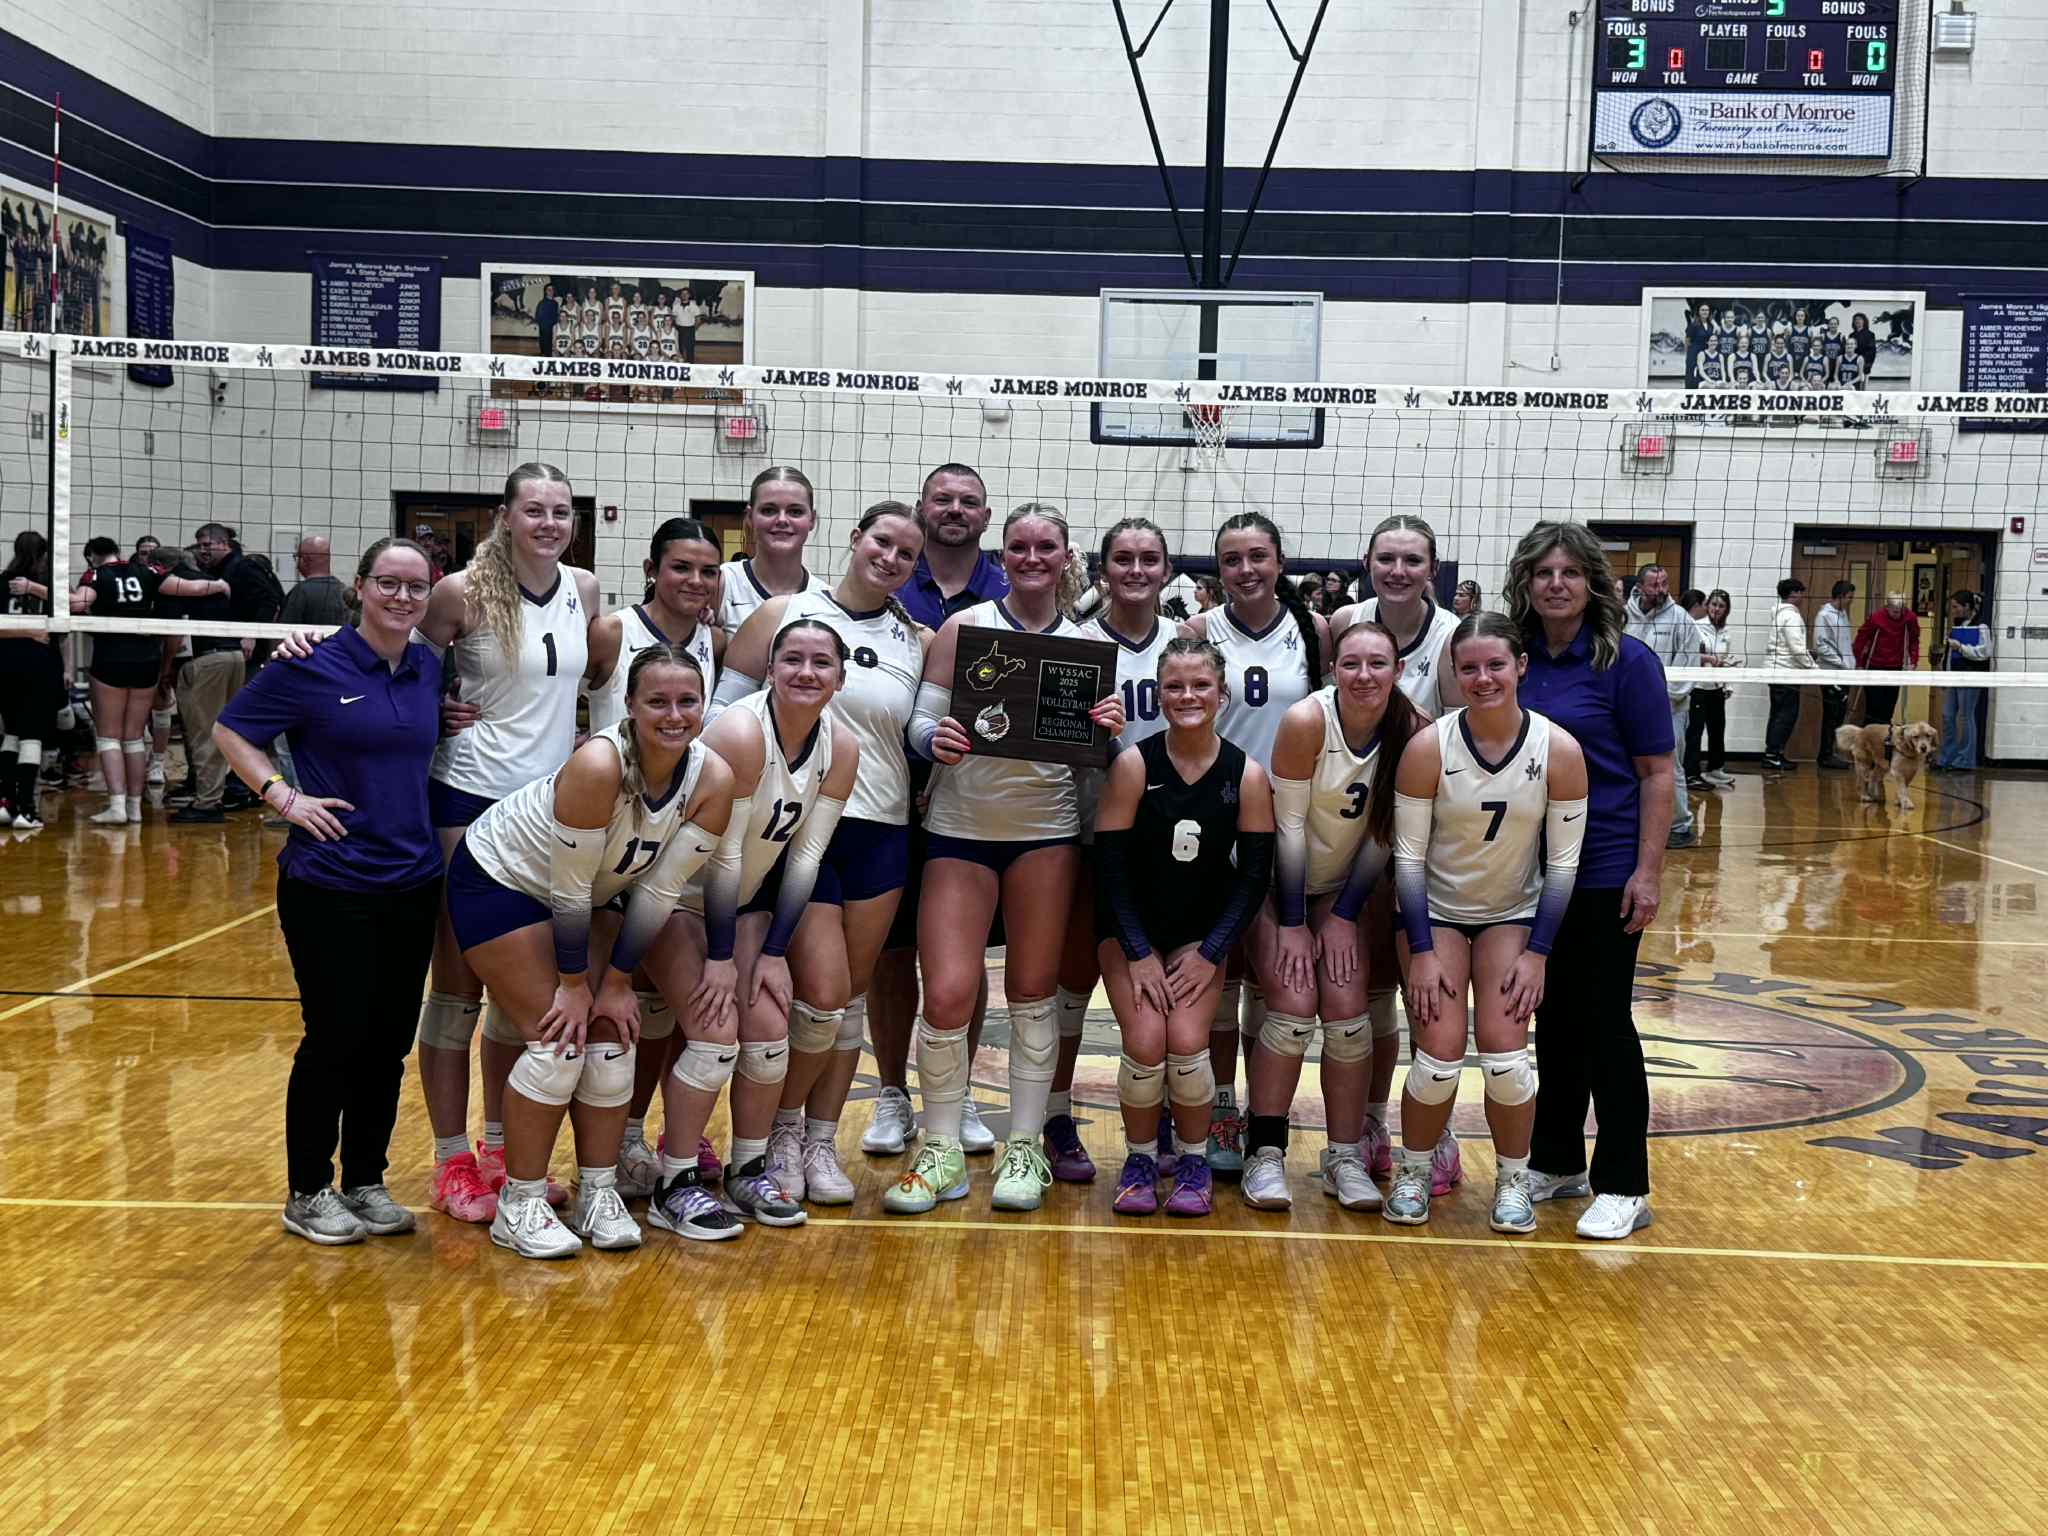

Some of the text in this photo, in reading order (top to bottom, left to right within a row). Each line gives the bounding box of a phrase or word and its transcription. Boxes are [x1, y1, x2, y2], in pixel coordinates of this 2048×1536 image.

[1632, 0, 1674, 12] BONUS
[1822, 2, 1865, 14] BONUS
[1607, 23, 1646, 35] FOULS
[1700, 24, 1747, 37] PLAYER
[1766, 25, 1806, 37] FOULS
[1848, 26, 1887, 38] FOULS
[1627, 38, 1645, 68] 3
[1670, 48, 1682, 68] 0
[1810, 50, 1822, 70] 0
[1867, 42, 1886, 71] 0
[1612, 72, 1638, 83] WON
[1663, 72, 1687, 84] TOL
[1726, 73, 1759, 84] GAME
[1802, 74, 1827, 86] TOL
[1852, 74, 1878, 86] WON
[1689, 102, 1856, 121] The Bank of Monroe
[1693, 121, 1753, 139] Focusing
[1776, 123, 1799, 132] Our
[1803, 122, 1848, 133] Future
[1696, 141, 1848, 151] www.mybankofmonroe.com
[71, 340, 230, 362] JAMES MONROE
[301, 350, 462, 372] JAMES MONROE
[532, 361, 691, 382] JAMES MONROE
[761, 369, 919, 391] JAMES MONROE
[990, 378, 1148, 399] JAMES MONROE
[1218, 385, 1377, 404] JAMES MONROE
[1448, 391, 1609, 409] JAMES MONROE
[1680, 394, 1844, 412] JAMES MONROE
[1917, 396, 1988, 414] JAMES
[115, 577, 143, 603] 19
[542, 633, 558, 677] 1
[1048, 666, 1093, 679] WVSSAC
[1059, 679, 1079, 687] 2025
[1243, 665, 1270, 708] 8
[1041, 696, 1091, 711] VOLLEYBALL
[1121, 678, 1161, 722] 10
[1042, 717, 1088, 730] REGIONAL
[1039, 727, 1089, 740] CHAMPION
[1340, 782, 1369, 820] 3
[760, 798, 803, 843] 12
[1481, 801, 1508, 842] 7
[1172, 819, 1201, 863] 6
[613, 837, 661, 875] 17
